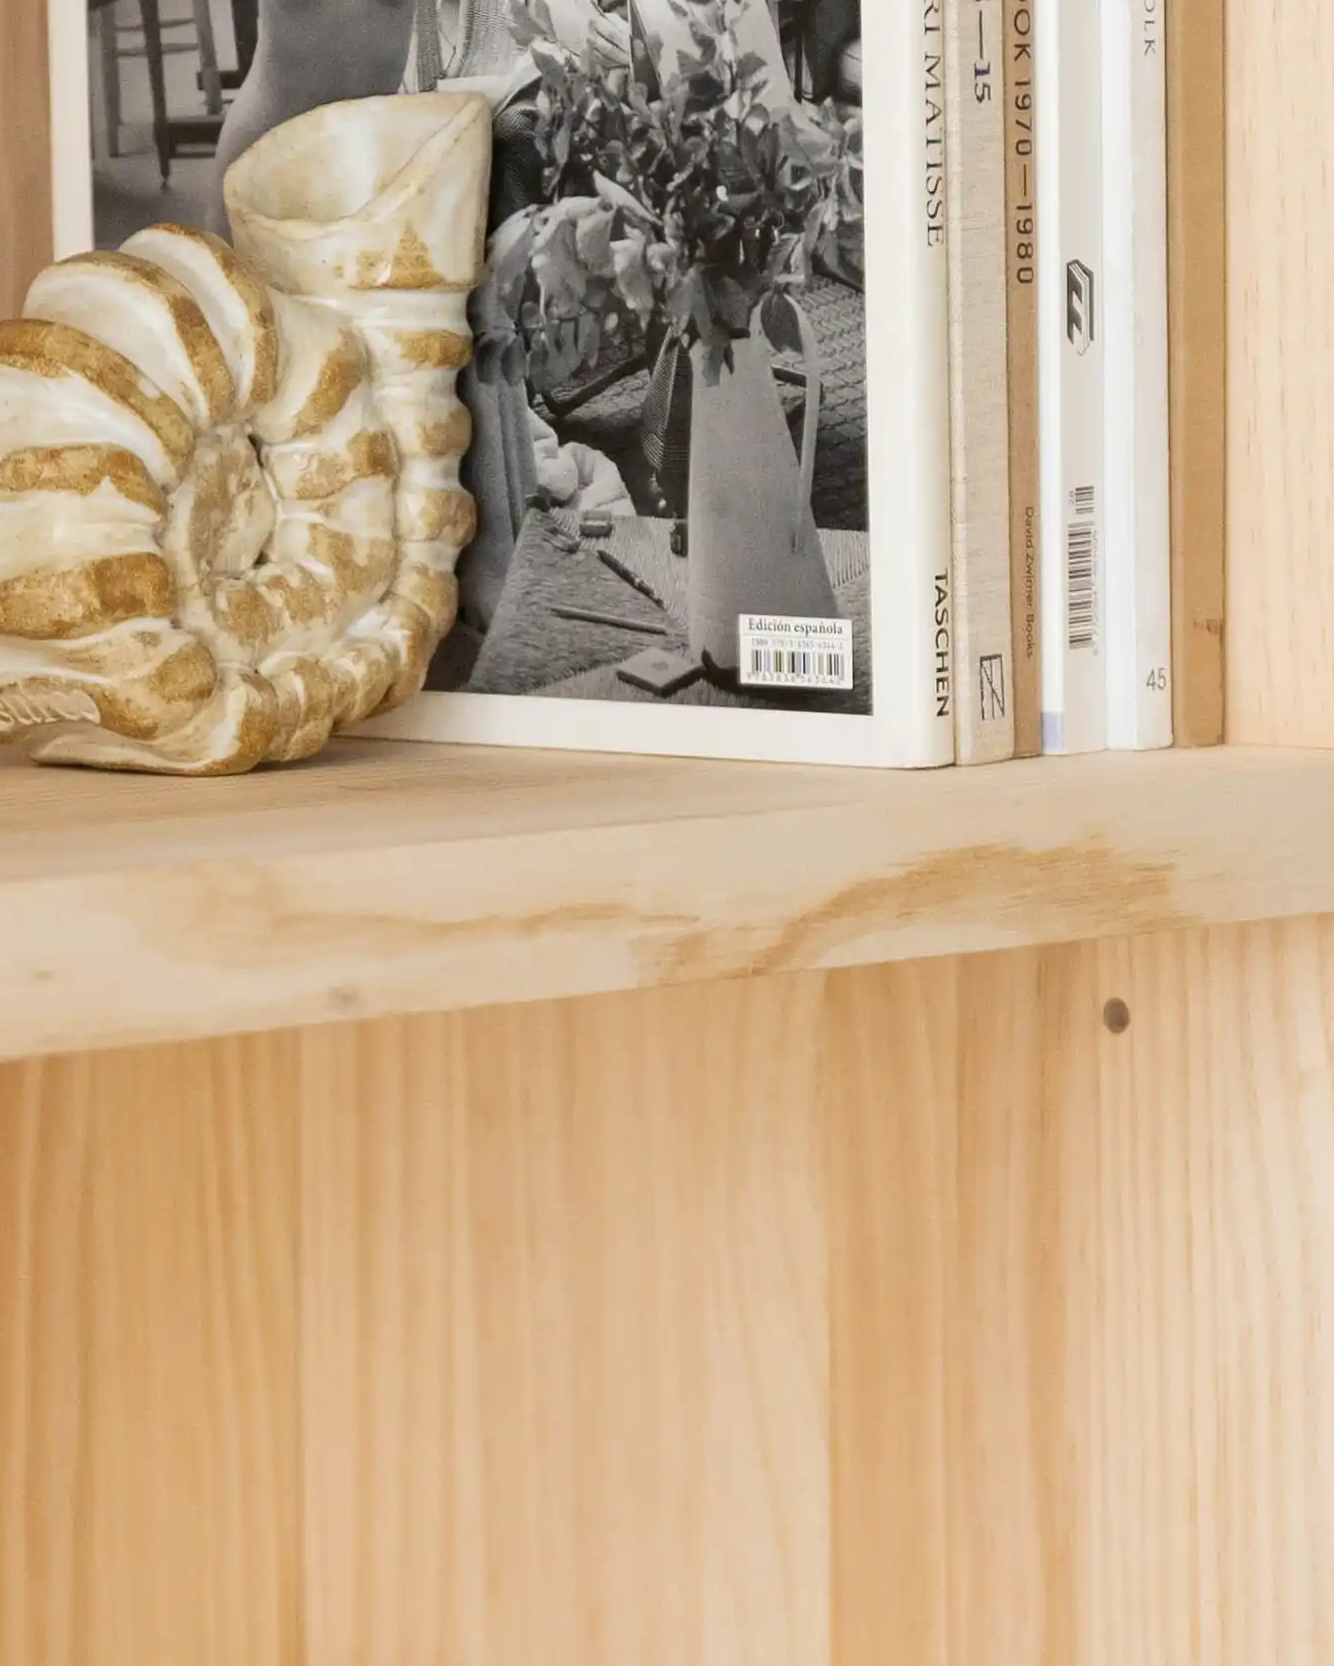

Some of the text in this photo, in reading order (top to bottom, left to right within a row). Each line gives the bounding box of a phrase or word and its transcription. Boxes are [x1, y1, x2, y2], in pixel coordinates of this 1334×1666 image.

[925, 52, 944, 246] MATISSE
[1024, 505, 1035, 550] David
[748, 617, 843, 637] Edición española
[934, 568, 950, 718] TASCHEN
[1025, 613, 1035, 659] Books
[1145, 666, 1167, 691] 45
